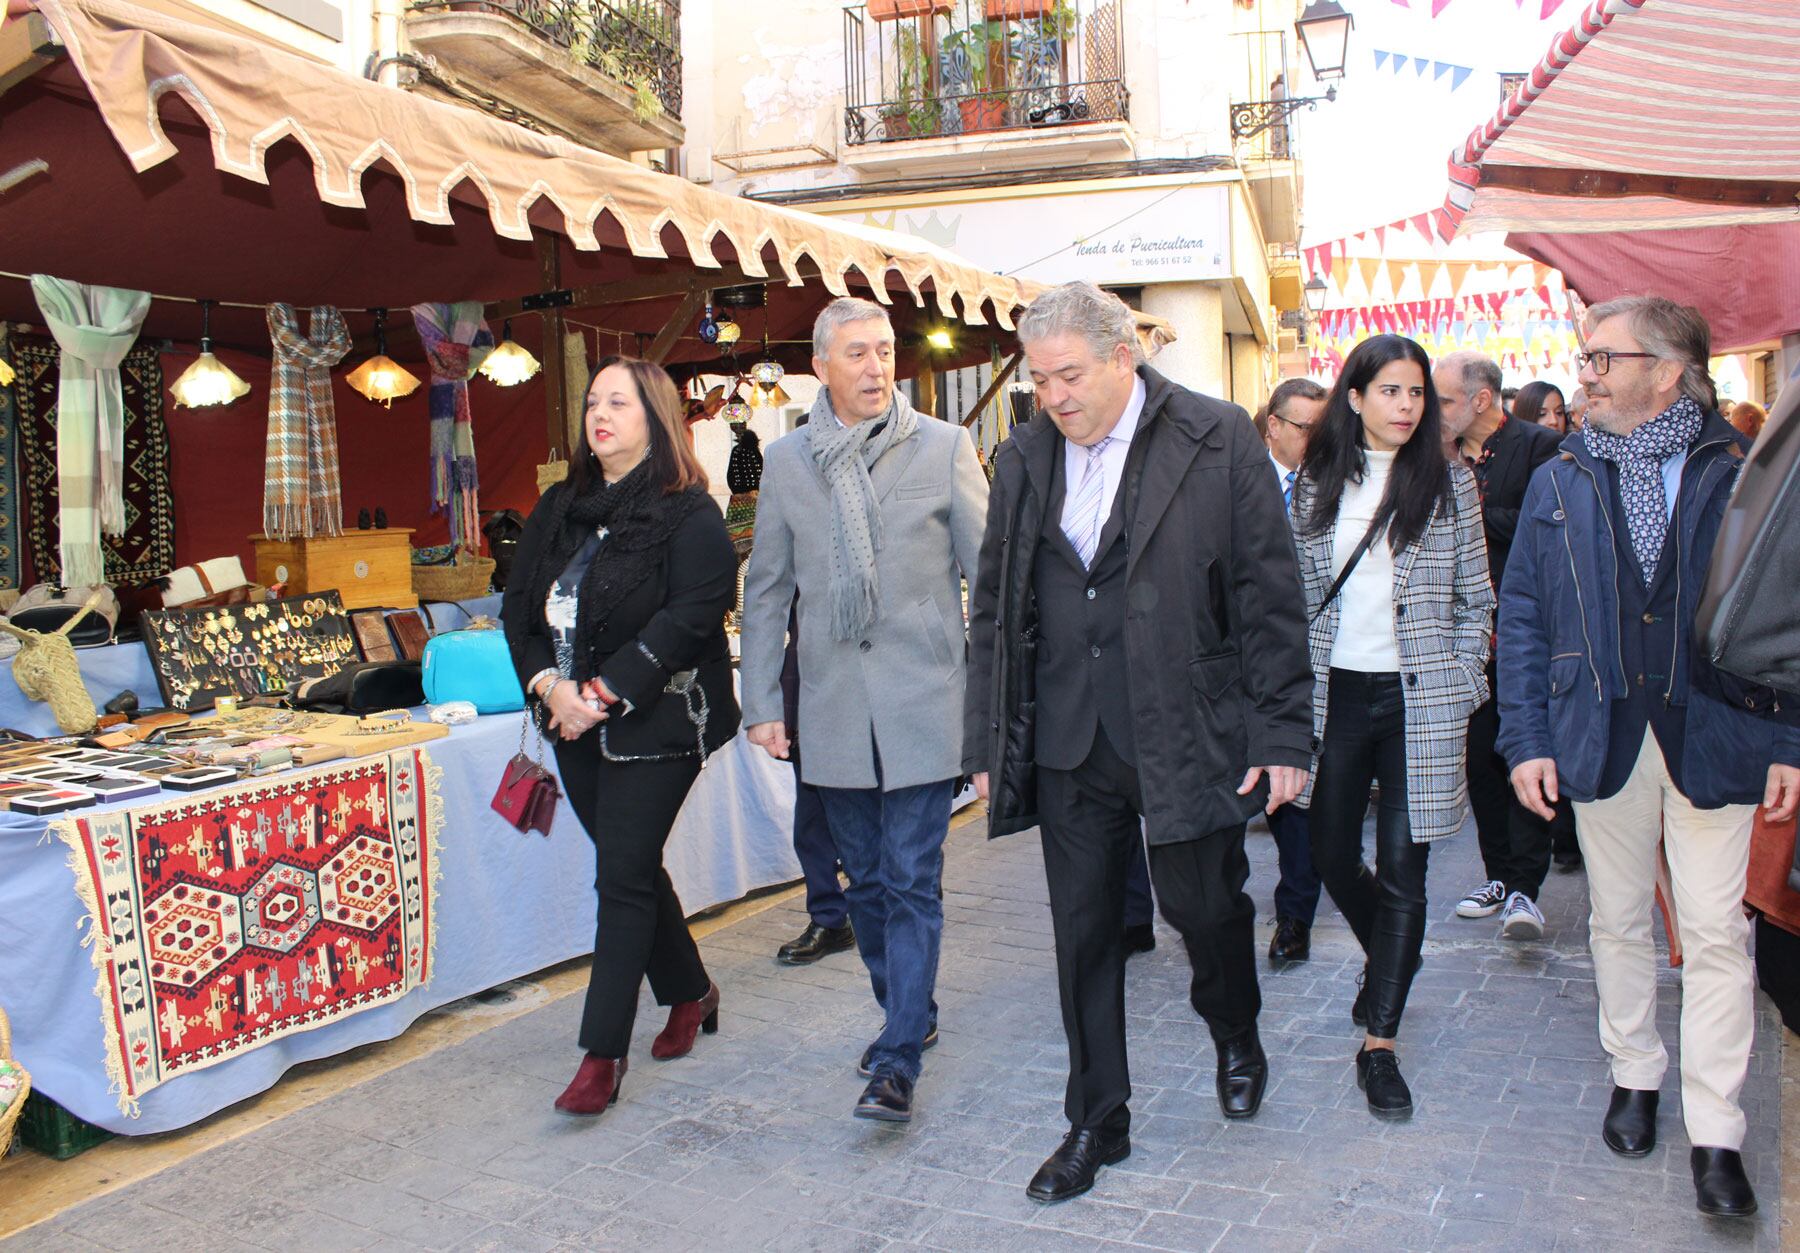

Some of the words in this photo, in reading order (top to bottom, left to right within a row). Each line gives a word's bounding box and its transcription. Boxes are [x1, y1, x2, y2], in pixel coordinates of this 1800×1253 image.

[1073, 239, 1107, 256] Tenda
[1111, 240, 1126, 254] de
[1130, 236, 1205, 253] Puericultura
[1145, 257, 1159, 266] 966
[1161, 256, 1170, 265] 51
[1171, 256, 1181, 265] 67
[1183, 255, 1193, 264] 52
